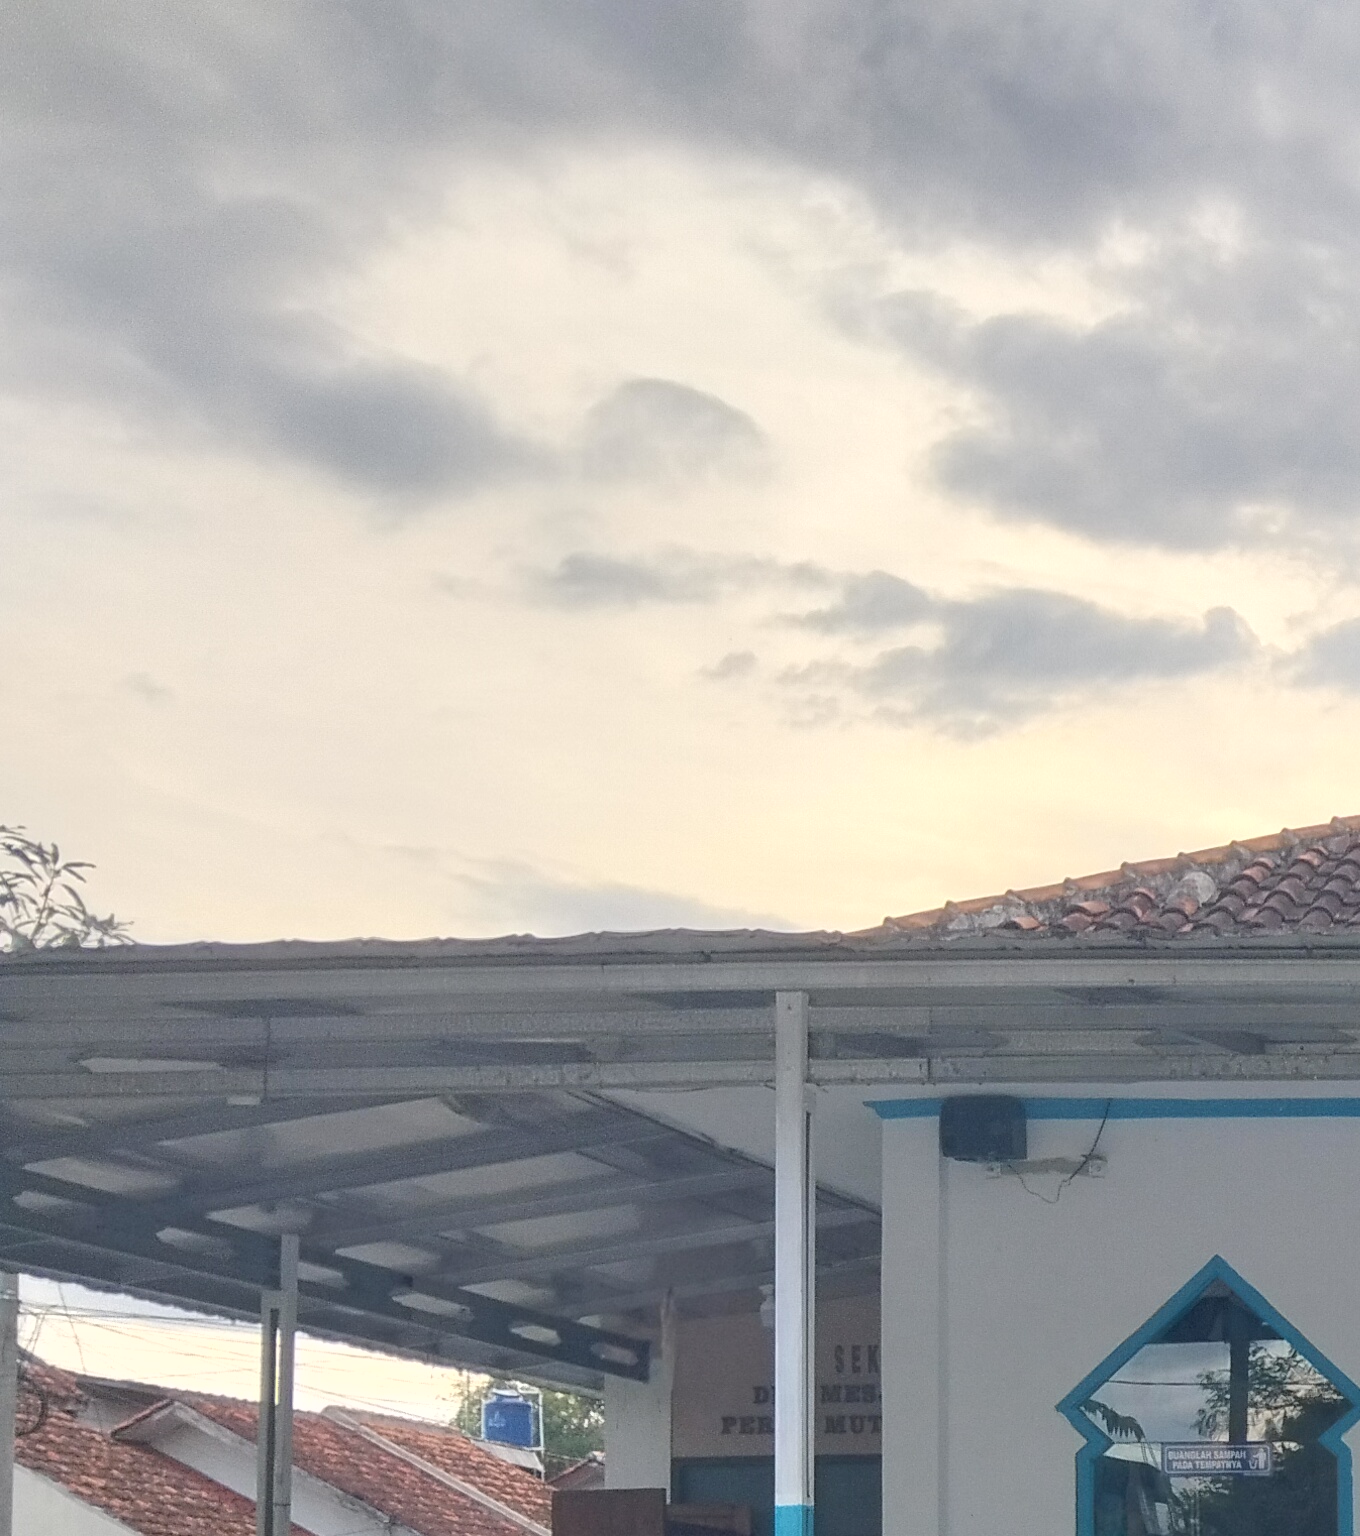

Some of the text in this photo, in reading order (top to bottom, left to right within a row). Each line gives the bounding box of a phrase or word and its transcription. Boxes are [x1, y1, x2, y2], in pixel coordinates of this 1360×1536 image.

[820, 1384, 882, 1404] MES
[1167, 1450, 1247, 1460] BUANGLAH SAMPAH
[1172, 1460, 1242, 1470] PADA TEMPATNYA
